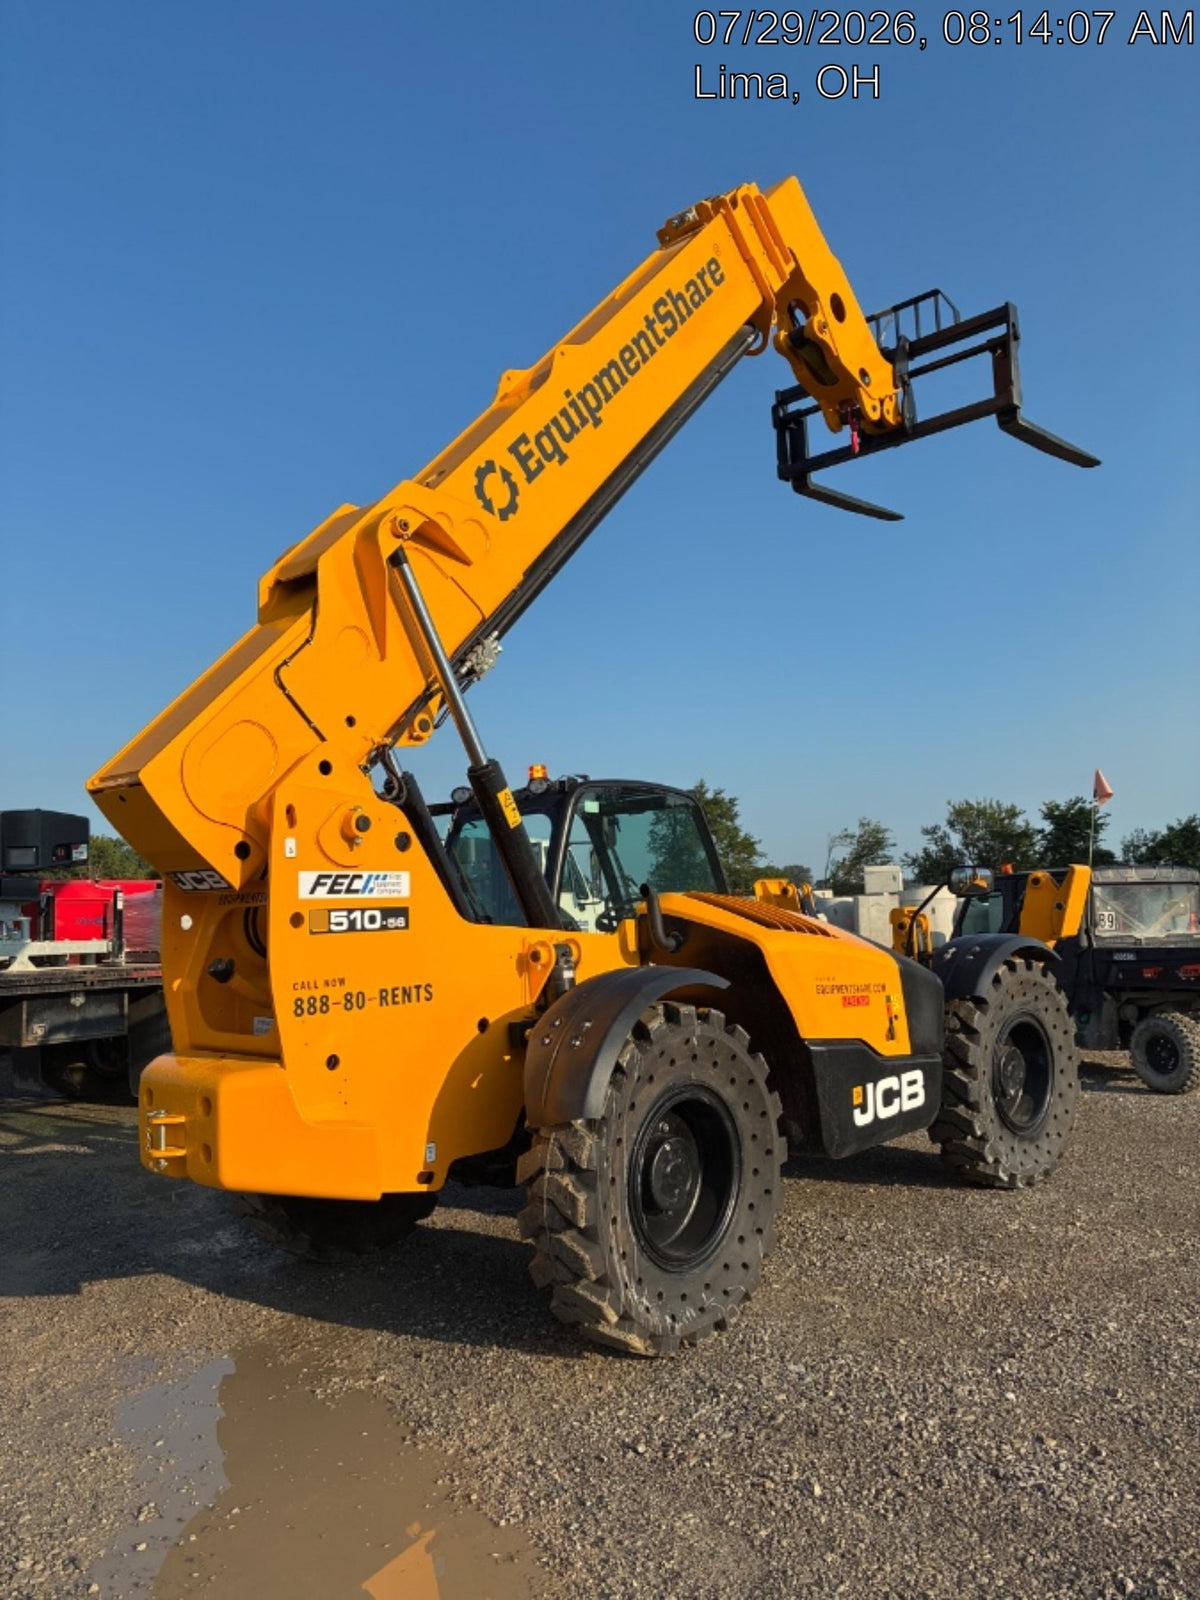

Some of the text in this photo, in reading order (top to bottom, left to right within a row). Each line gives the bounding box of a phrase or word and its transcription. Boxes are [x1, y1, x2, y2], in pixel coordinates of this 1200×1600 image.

[507, 257, 725, 484] EquipmentShare
[176, 870, 229, 890] JCB
[308, 874, 363, 895] FEC
[292, 977, 346, 991] CALL NOW
[293, 983, 433, 1018] 888-80-RENTS
[853, 1069, 926, 1127] JCB
